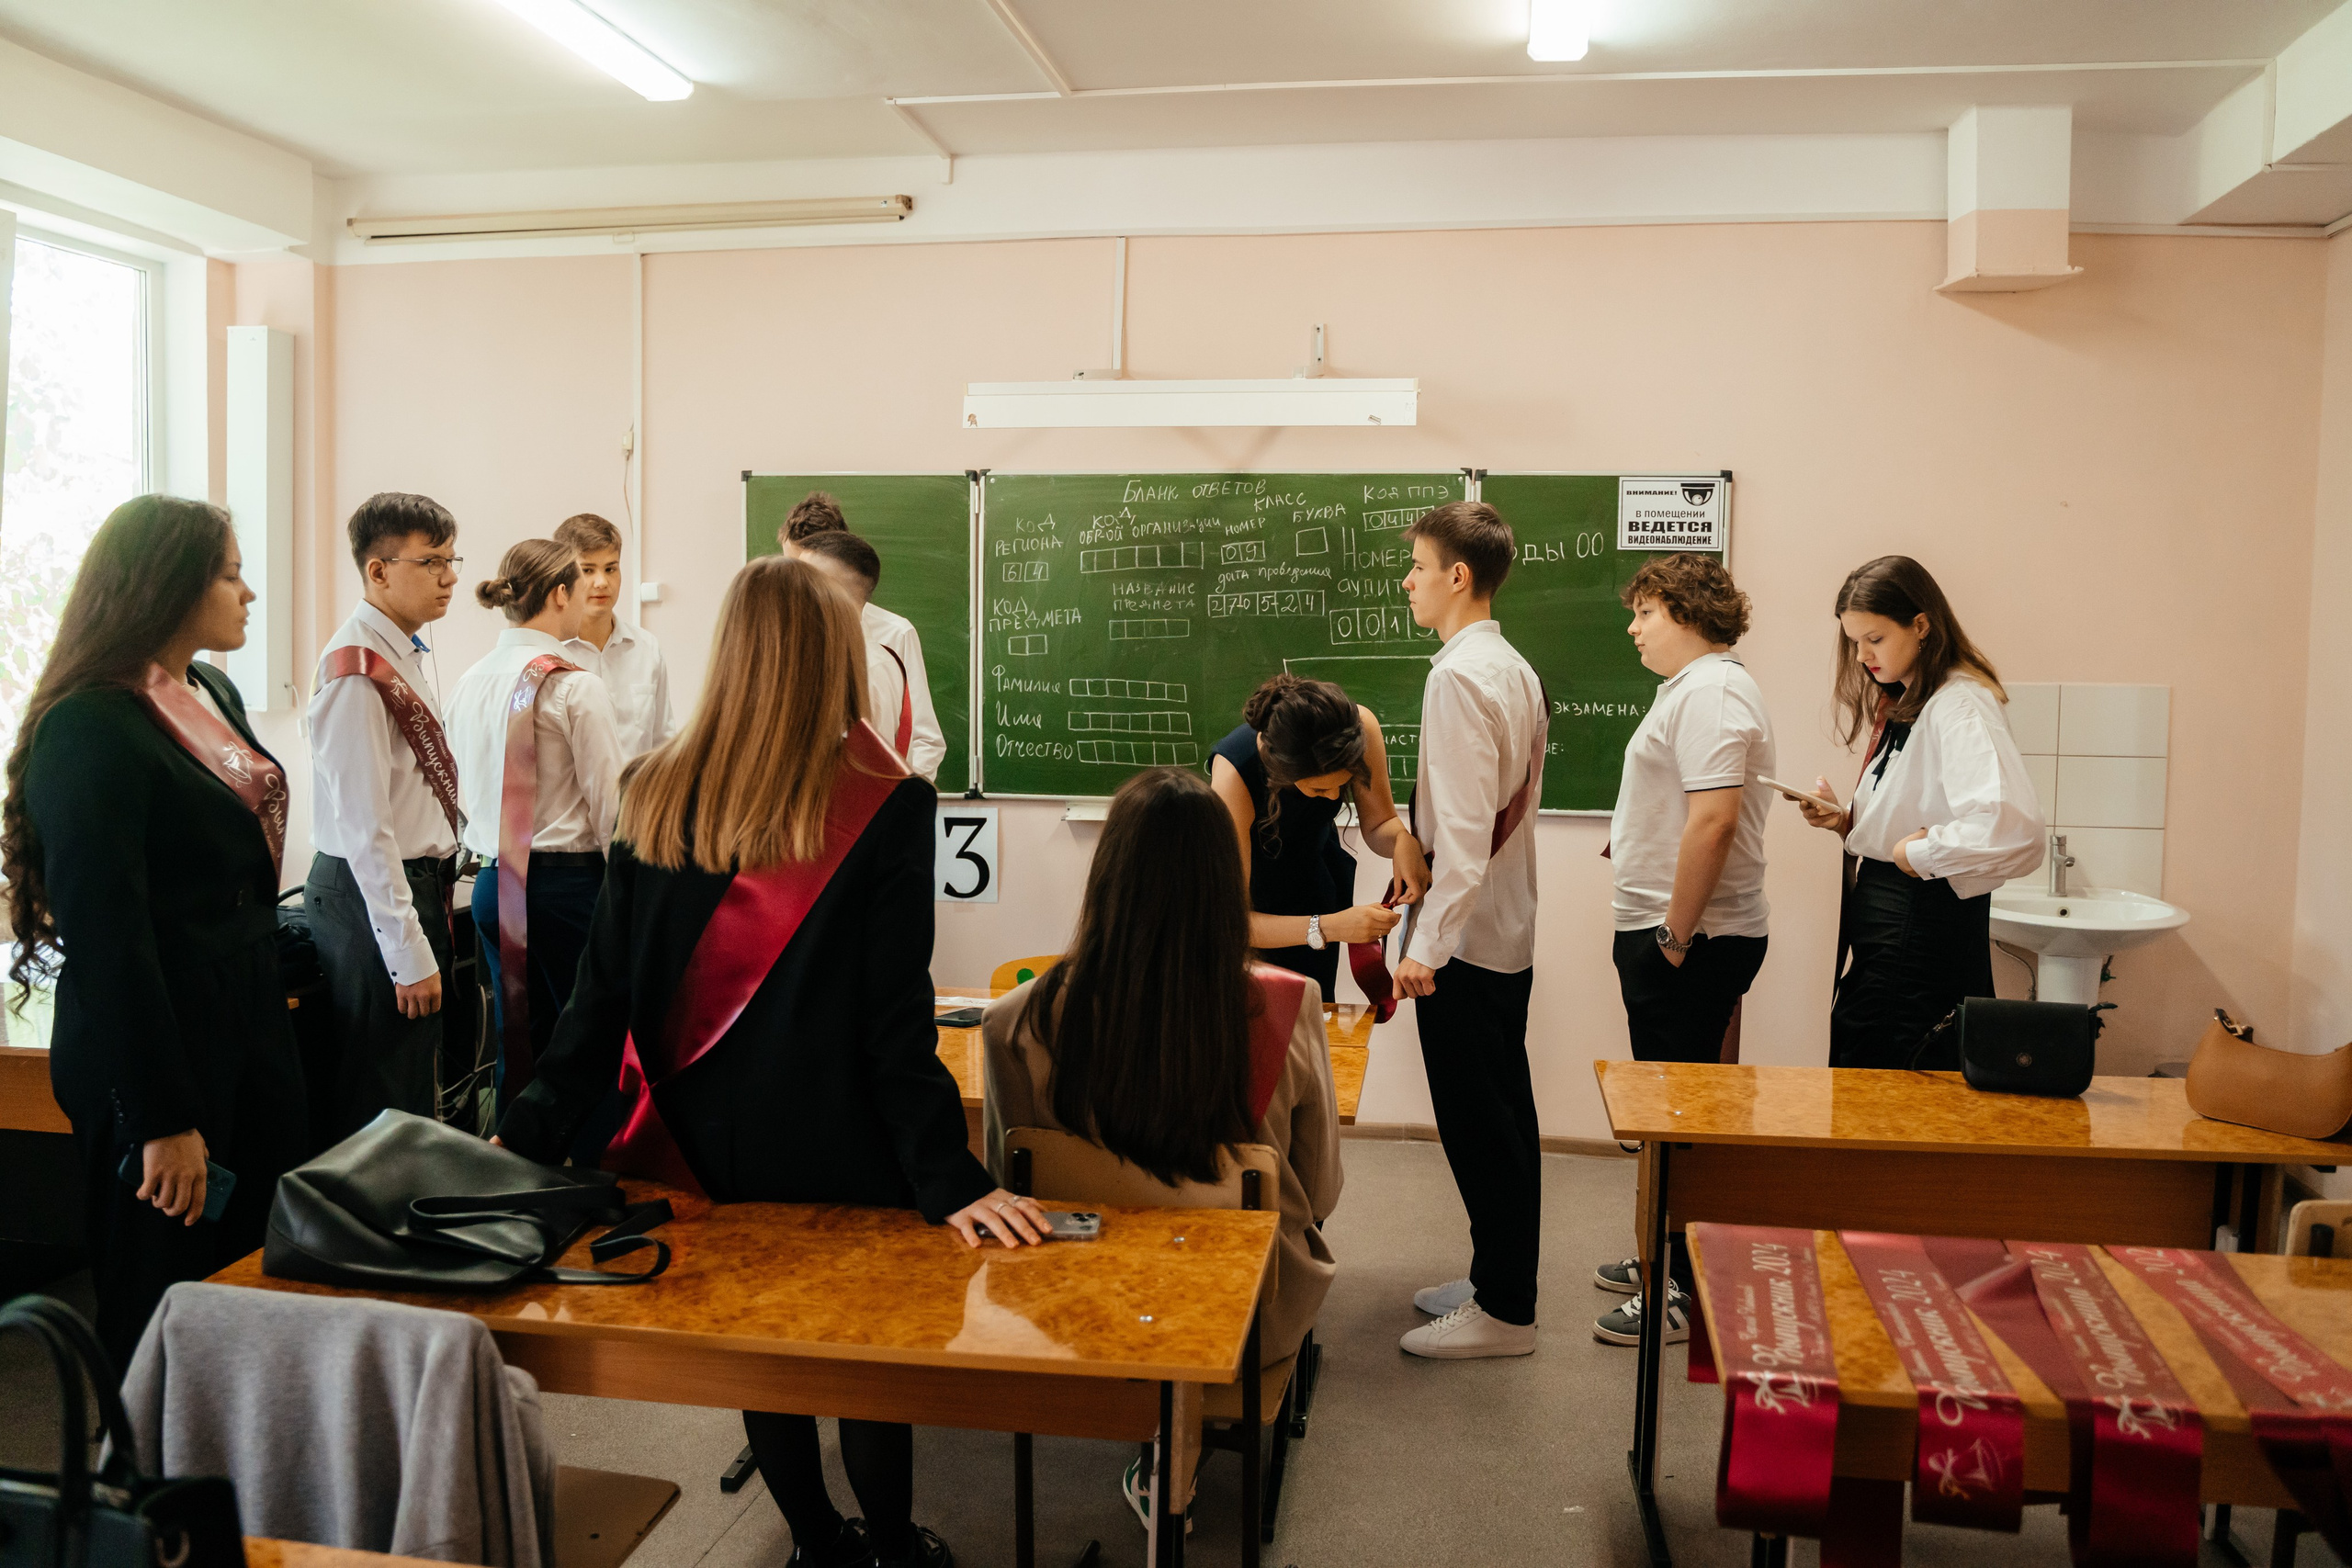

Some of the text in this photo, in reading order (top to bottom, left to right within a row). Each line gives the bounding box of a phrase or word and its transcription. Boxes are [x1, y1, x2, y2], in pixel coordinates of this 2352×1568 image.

[1192, 479, 1267, 498] ОТВЕТОВ
[1408, 485, 1449, 499] ППЭ
[1253, 491, 1306, 513] КЛАСС
[1293, 502, 1347, 524] БУКВА
[1015, 513, 1056, 533] КОД
[1092, 506, 1136, 530] КОД
[1635, 510, 1705, 519] в помещении
[1225, 517, 1266, 536] НОМЕР
[1628, 521, 1713, 534] ВЕДЕТСЯ
[995, 535, 1064, 558] РЕГИОНА
[1627, 536, 1713, 546] ВИДЕОНАБЛЮДЕНИЕ
[993, 596, 1028, 619] КОД
[989, 607, 1082, 633] ПРЕДМЕТА
[995, 700, 1042, 729] Имя
[1554, 701, 1646, 716] ЭКЗАМЕНА:
[943, 817, 990, 898] 3
[1751, 1242, 1792, 1275] 2024
[1878, 1269, 1932, 1304] 2024
